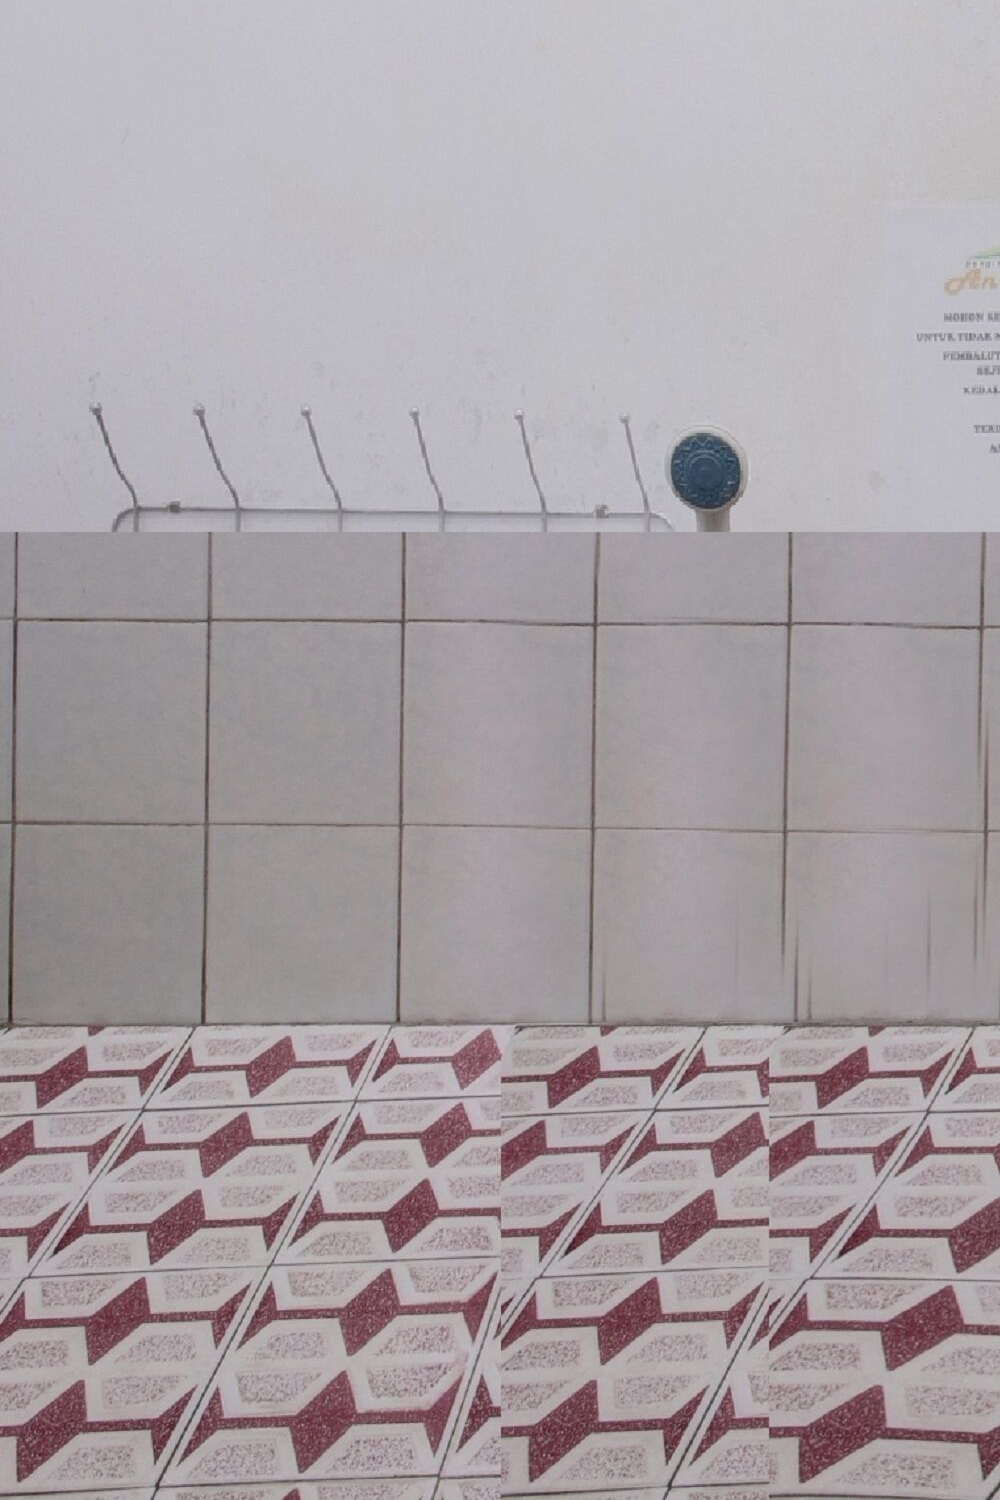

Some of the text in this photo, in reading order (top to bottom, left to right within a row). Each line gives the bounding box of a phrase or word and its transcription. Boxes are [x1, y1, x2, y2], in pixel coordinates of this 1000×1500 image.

[944, 268, 997, 295] An
[943, 312, 984, 322] MOHON
[916, 332, 956, 342] UNTUK
[958, 332, 991, 341] TIDAK
